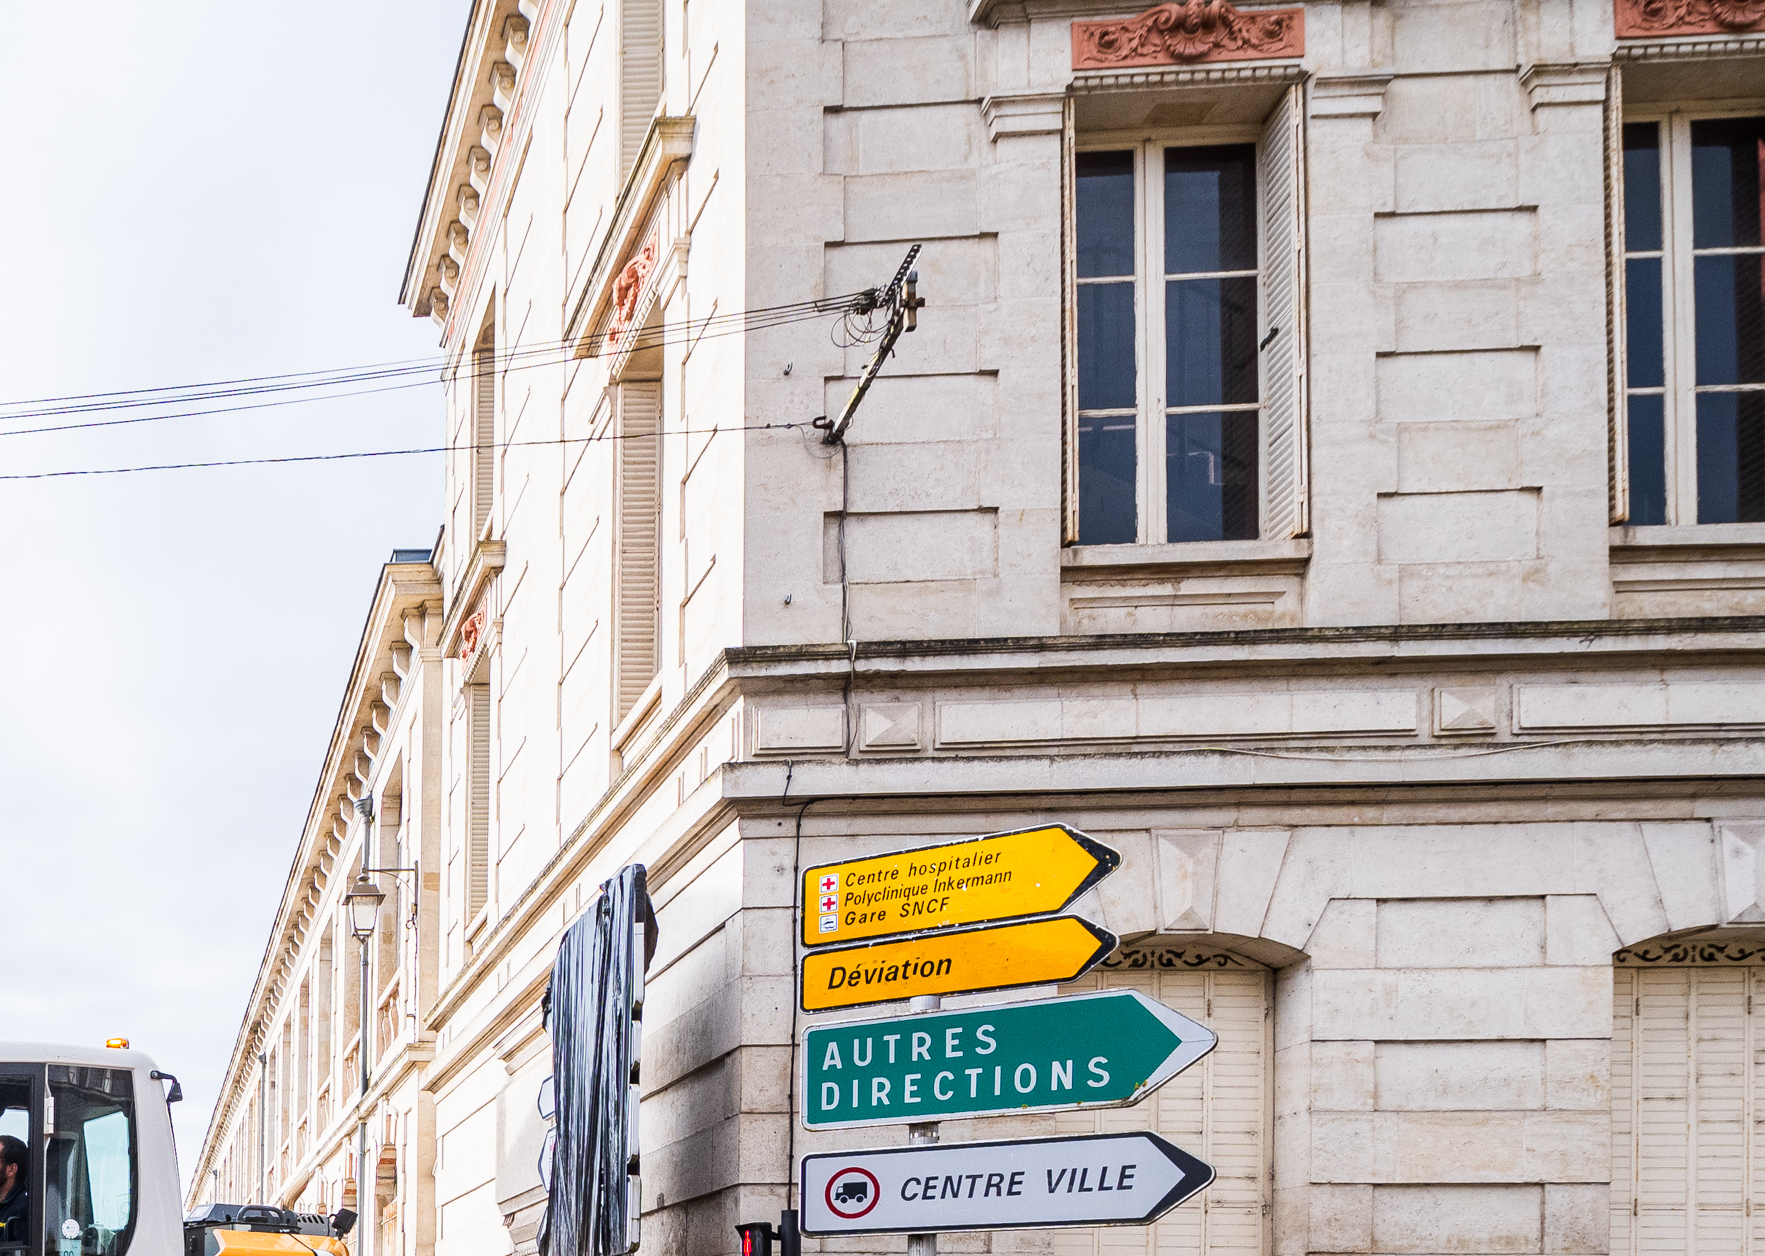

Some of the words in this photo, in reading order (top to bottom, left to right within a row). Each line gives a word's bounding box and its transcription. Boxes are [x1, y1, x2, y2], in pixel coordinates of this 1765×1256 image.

[845, 868, 899, 887] Centre
[908, 851, 1001, 877] hospitalier
[844, 883, 928, 907] Polyclinique
[933, 870, 1012, 893] Inkermann
[844, 910, 887, 926] Gare
[899, 897, 950, 918] SNCF
[827, 955, 953, 990] Déviation
[822, 1025, 998, 1071] AUTRES
[821, 1056, 1111, 1111] DIRECTIONS
[900, 1171, 1026, 1201] CENTRE
[1045, 1165, 1137, 1195] VILLE
